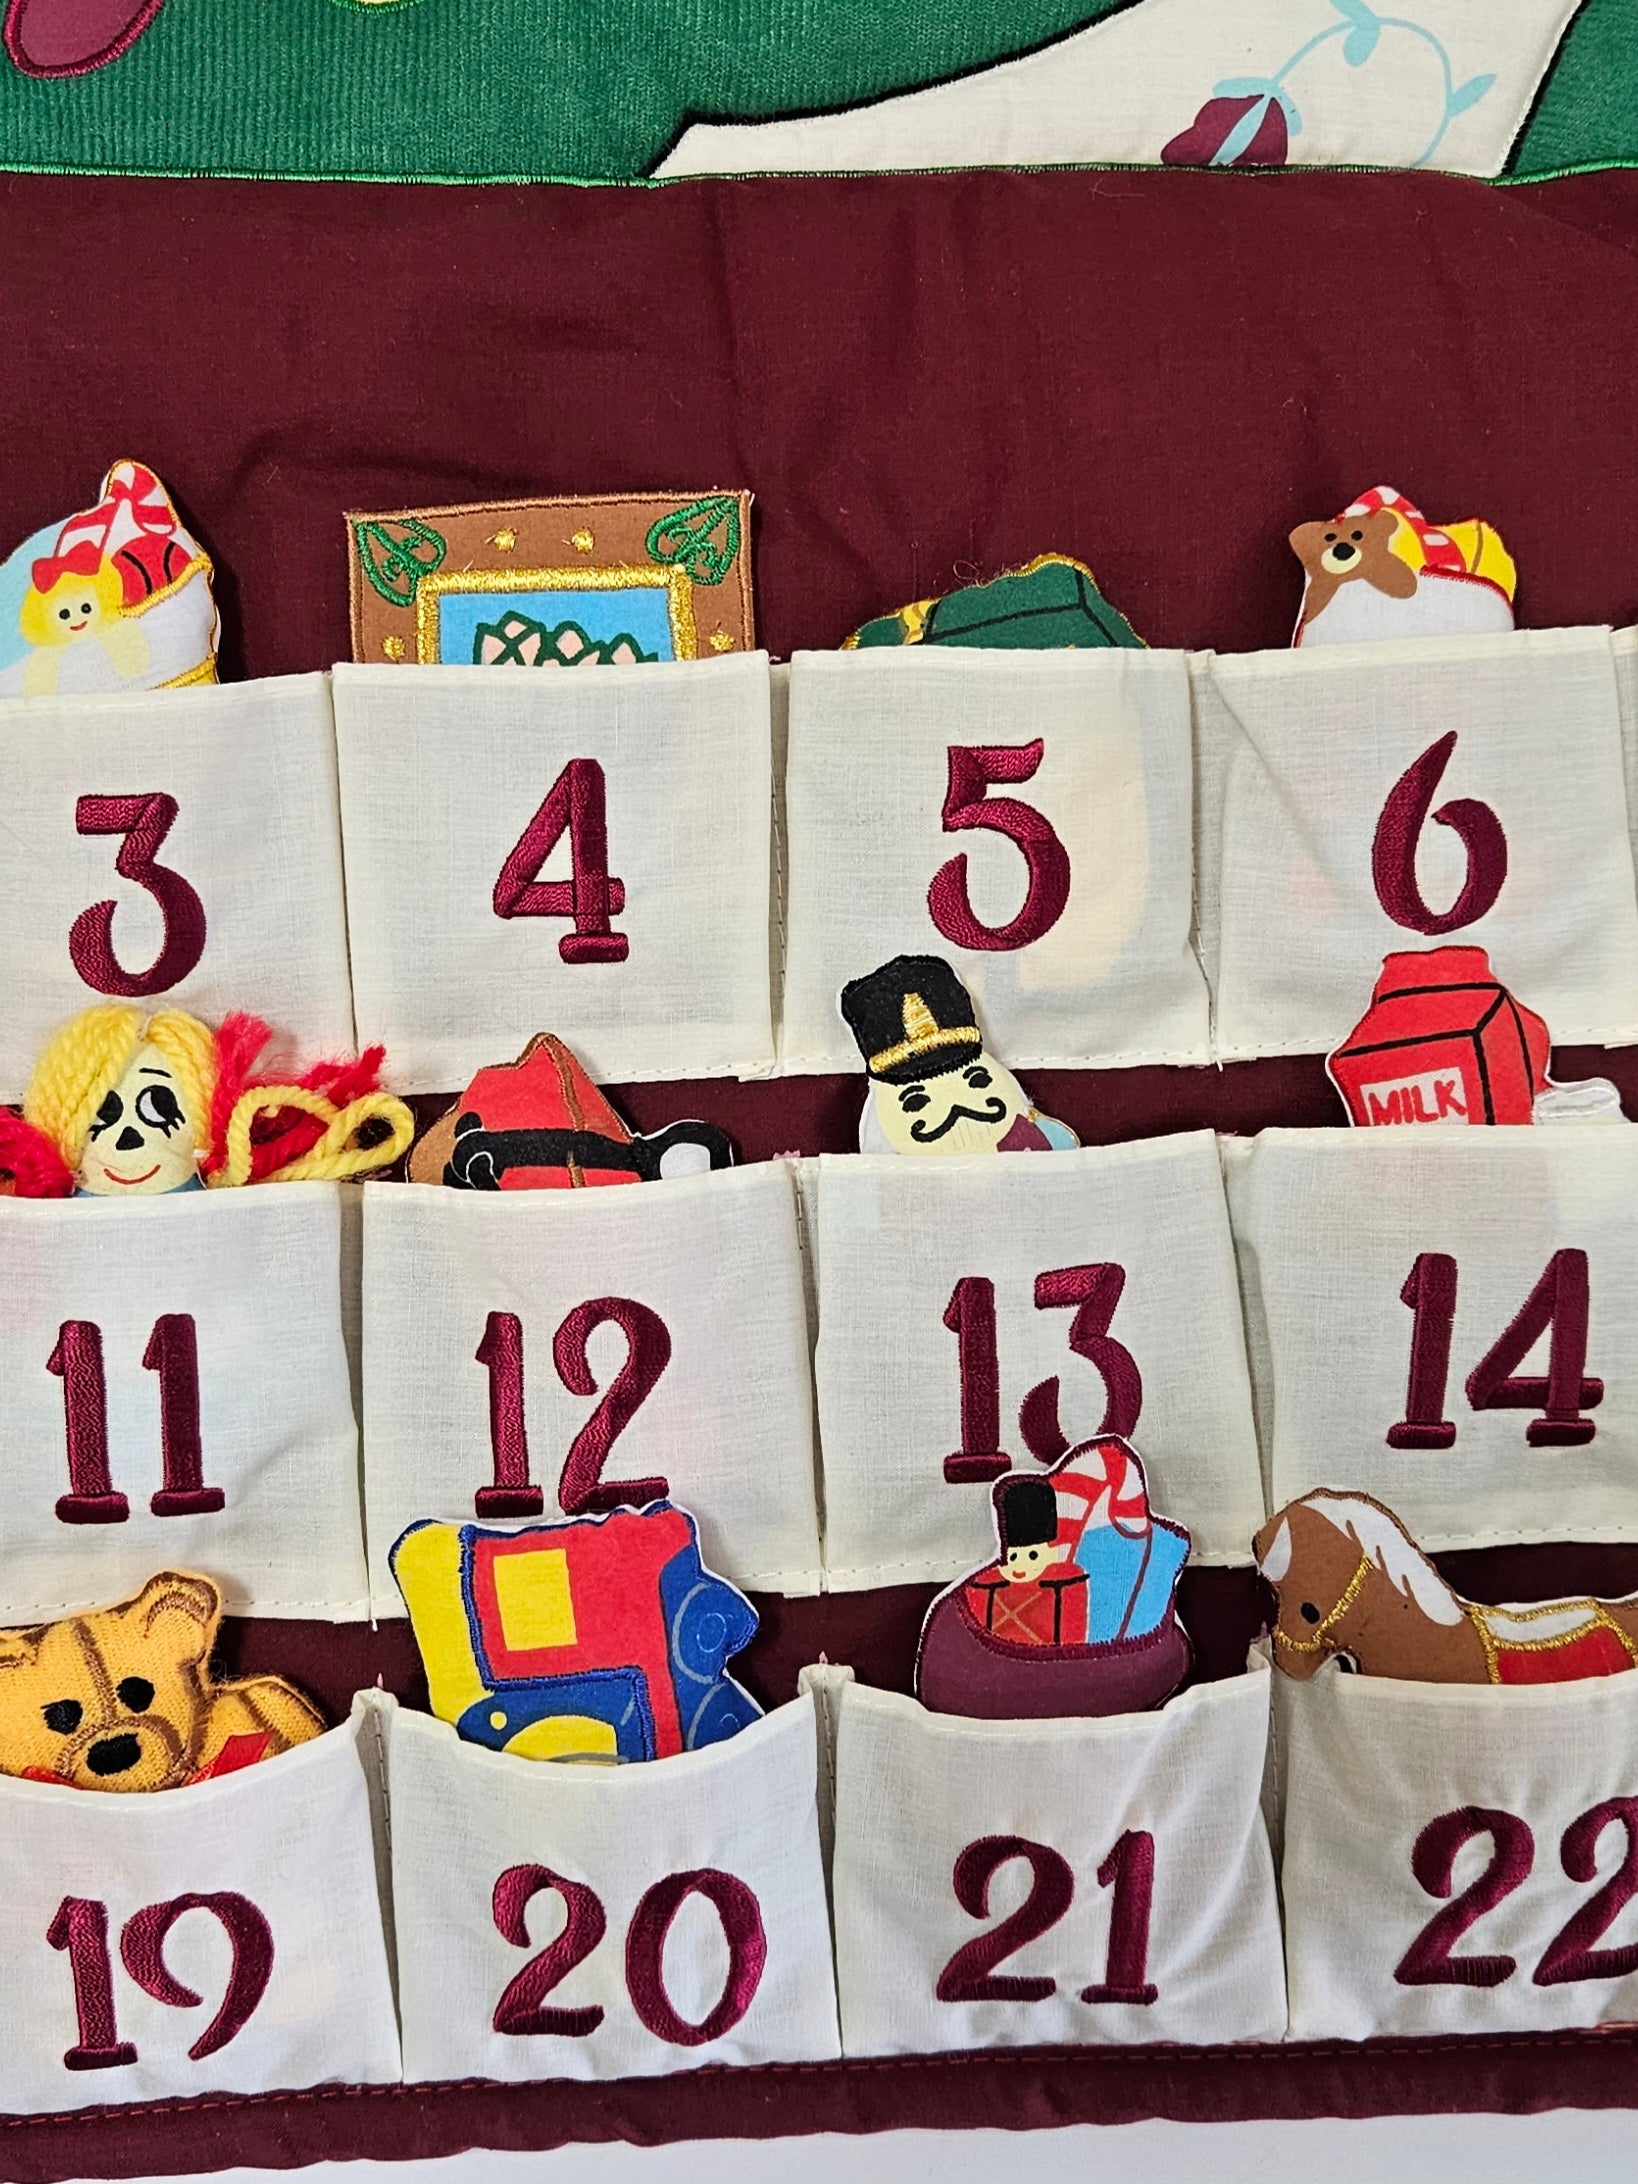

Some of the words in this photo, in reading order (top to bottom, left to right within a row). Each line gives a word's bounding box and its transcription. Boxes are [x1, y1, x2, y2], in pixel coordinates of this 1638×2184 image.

[69, 792, 206, 997] 3
[493, 759, 629, 964] 4
[928, 738, 1070, 951] 5
[1372, 731, 1507, 936] 6
[1368, 1079, 1468, 1125] MILK
[46, 1314, 225, 1524] 11
[475, 1297, 673, 1518] 12
[943, 1262, 1144, 1485] 13
[1386, 1248, 1604, 1448] 14
[47, 1892, 274, 2070] 19
[492, 1864, 767, 2046] 20
[936, 1829, 1158, 2004] 21
[1395, 1796, 1638, 1987] 22
